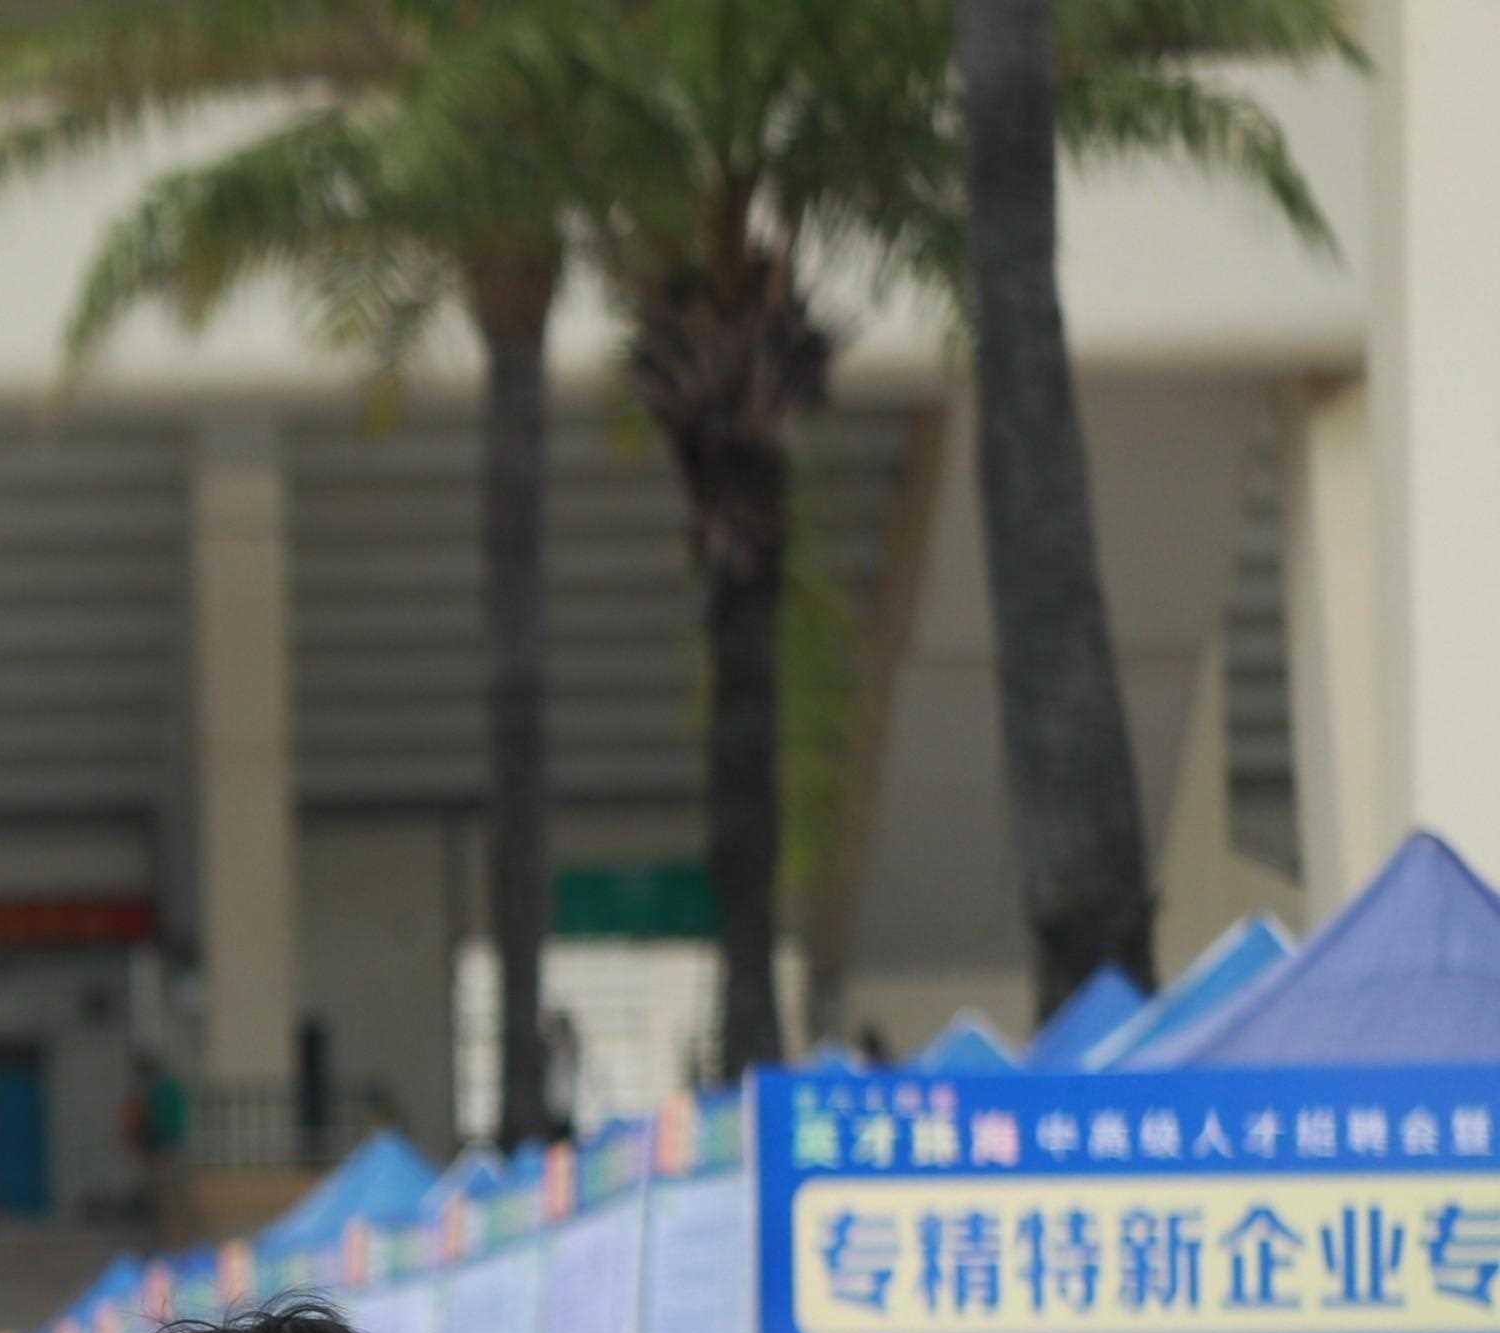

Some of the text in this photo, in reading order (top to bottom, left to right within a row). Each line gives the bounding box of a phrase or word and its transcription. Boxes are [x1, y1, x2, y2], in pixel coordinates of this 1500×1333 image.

[820, 1202, 1500, 1314] 专精特新企业专
